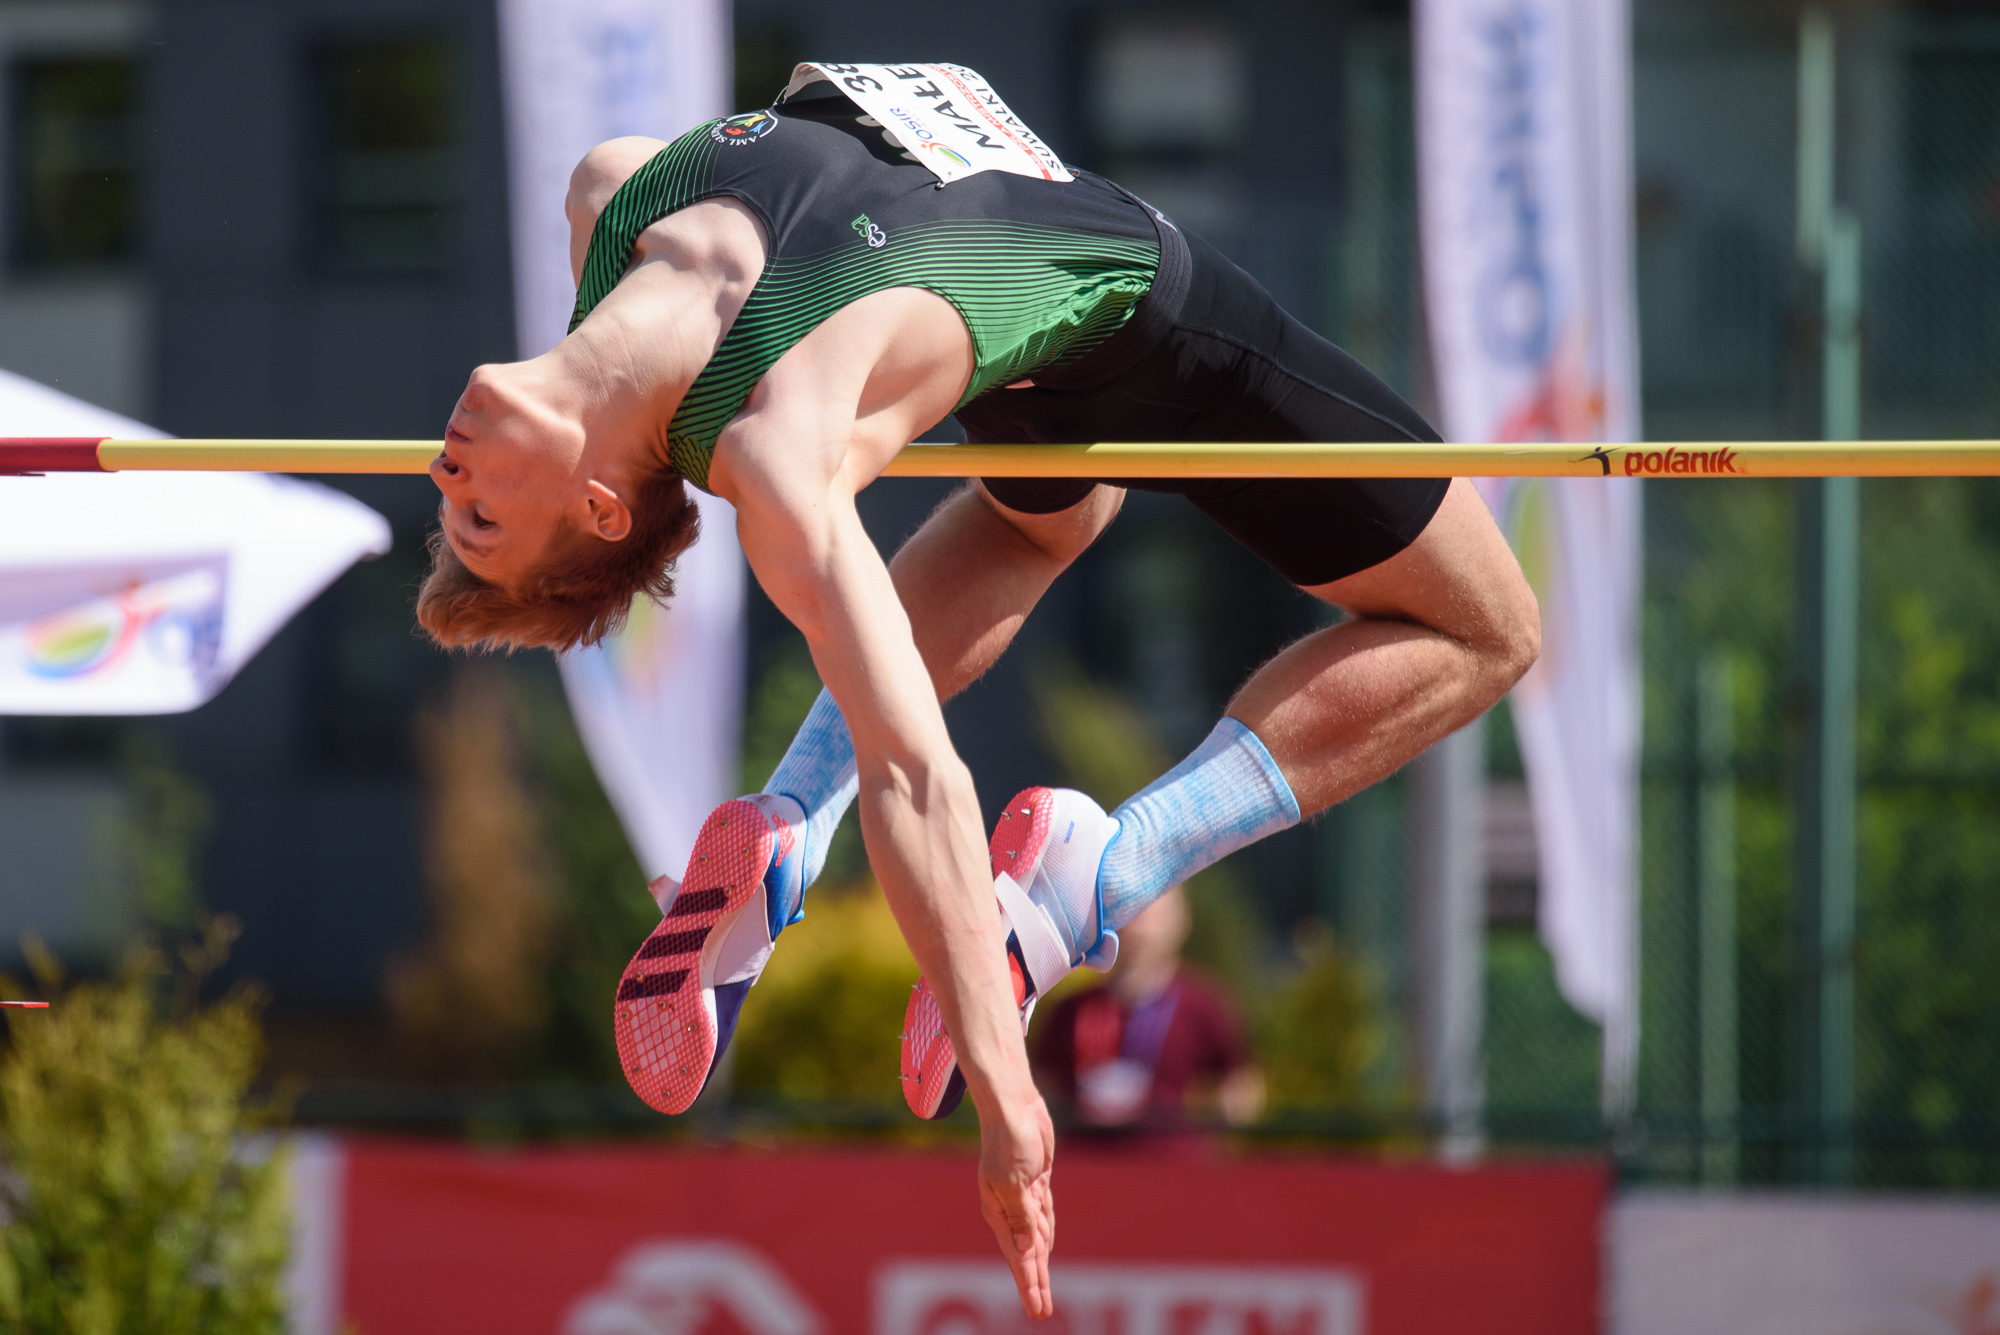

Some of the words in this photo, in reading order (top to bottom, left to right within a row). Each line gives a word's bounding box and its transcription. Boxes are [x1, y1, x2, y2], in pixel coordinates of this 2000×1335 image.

[878, 63, 1006, 149] MAŁE
[975, 88, 1061, 172] SUWAŁKI
[730, 135, 757, 146] AML
[1624, 446, 1738, 477] polanik
[772, 813, 787, 868] adidas
